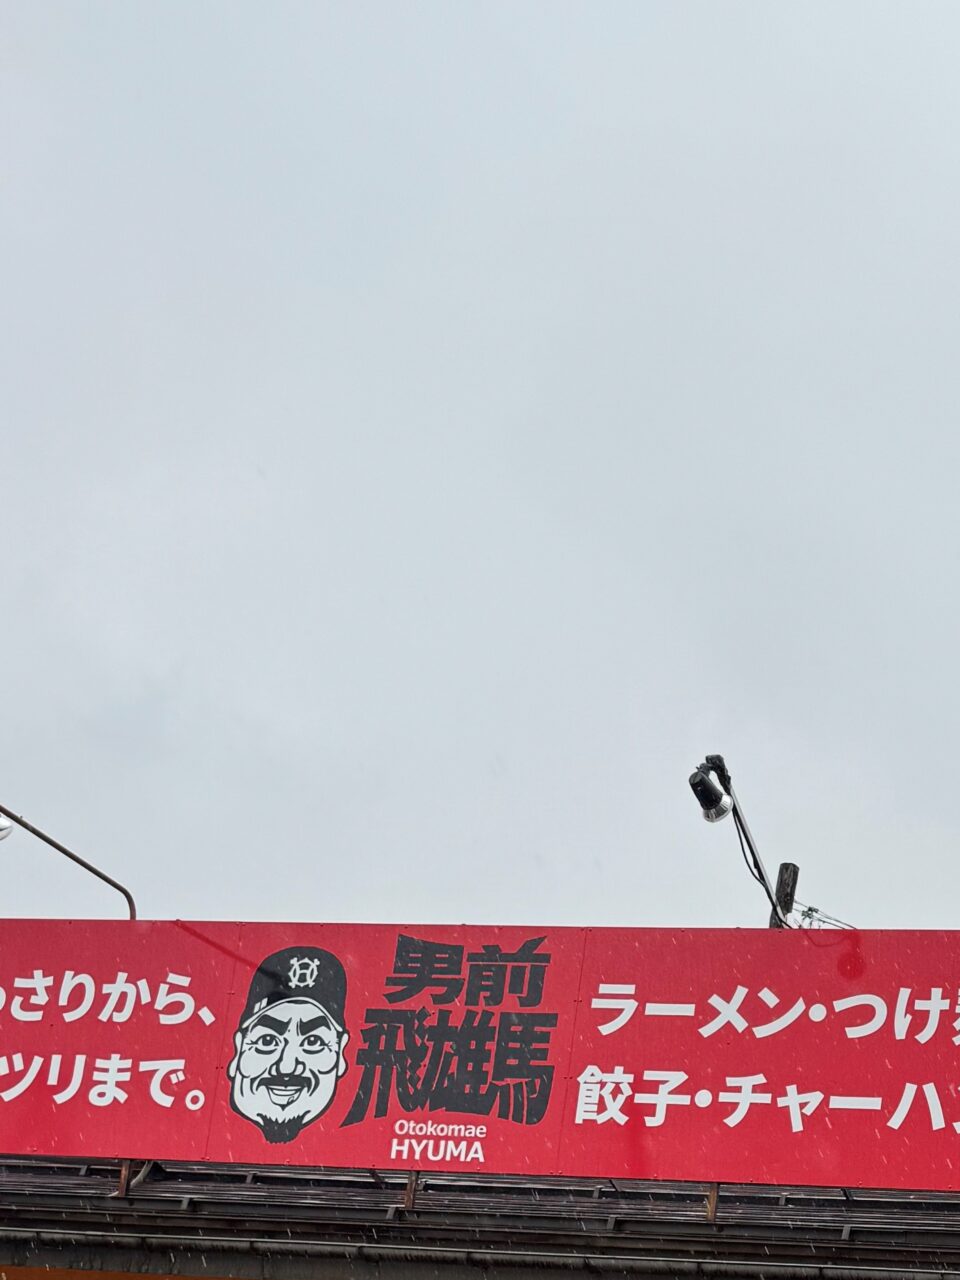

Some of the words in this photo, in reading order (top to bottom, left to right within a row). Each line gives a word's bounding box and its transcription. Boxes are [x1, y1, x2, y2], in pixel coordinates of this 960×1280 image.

[0, 970, 216, 1027] さりから、
[384, 934, 552, 1008] 男前
[339, 1007, 558, 1128] 飛雄馬
[390, 1139, 485, 1162] HYUMA
[394, 1119, 487, 1139] Otokomae
